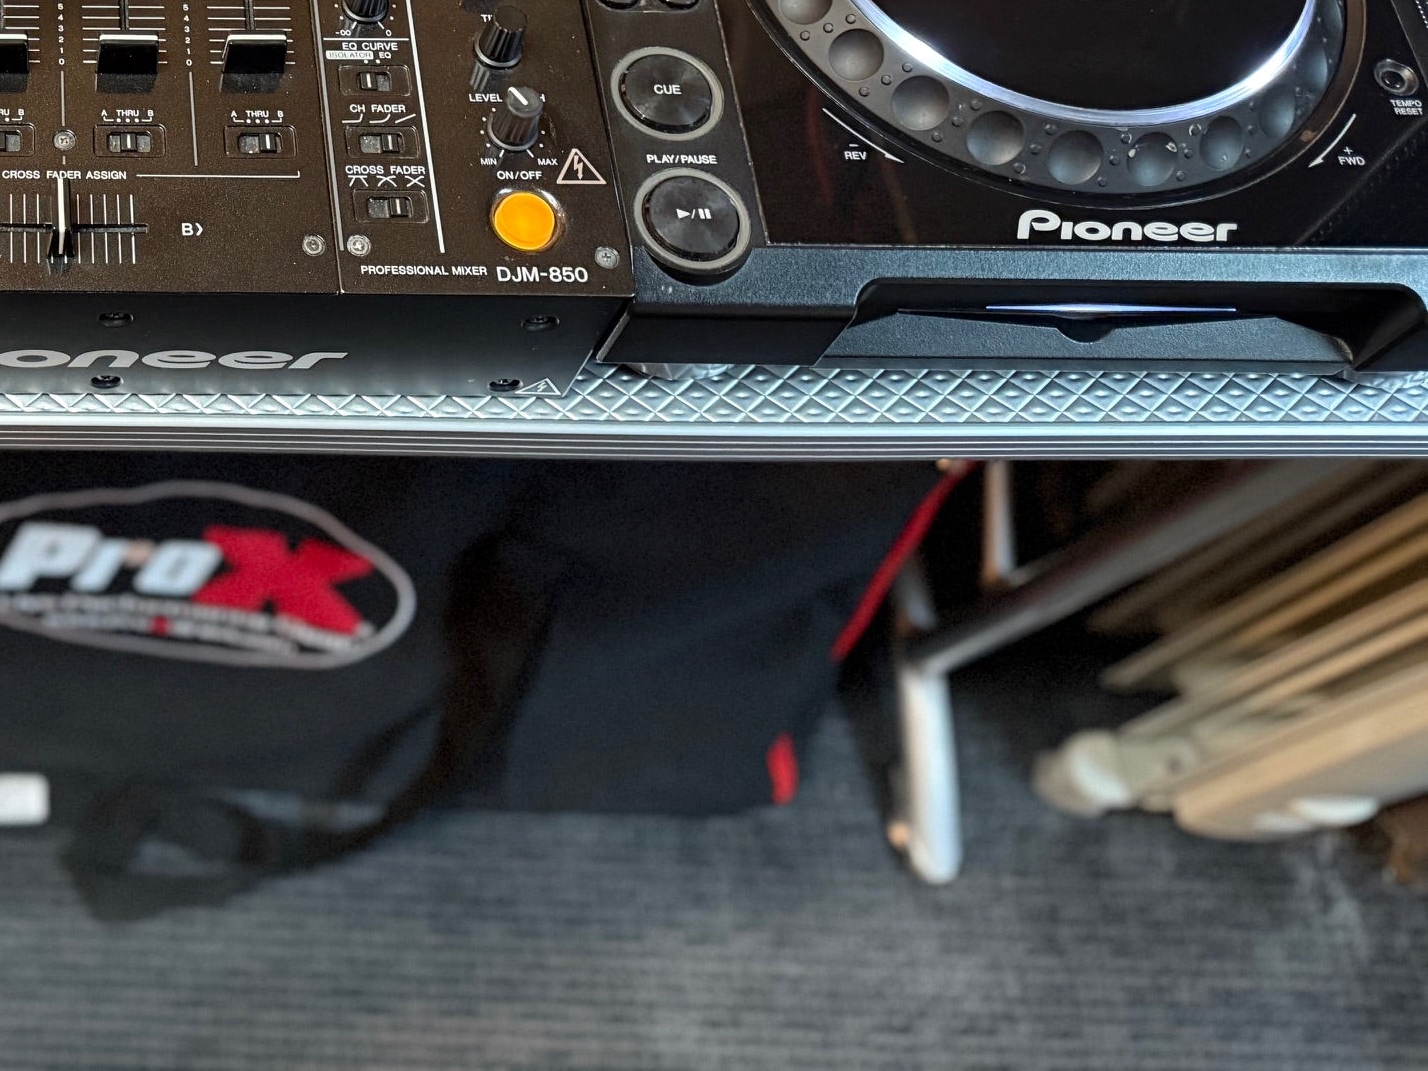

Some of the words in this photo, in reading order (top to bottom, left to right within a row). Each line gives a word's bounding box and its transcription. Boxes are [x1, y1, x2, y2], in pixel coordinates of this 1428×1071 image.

[342, 42, 357, 51] EQ
[362, 42, 398, 50] CURVE
[653, 84, 681, 95] CUE
[469, 94, 502, 102] LEVEL
[350, 105, 365, 113] CH
[371, 105, 406, 113] FADER
[1394, 107, 1423, 115] RESET
[646, 154, 718, 164] PLAY/PAUSE
[845, 151, 866, 160] REV
[538, 158, 558, 166] MAX
[1338, 157, 1365, 166] FWD
[345, 166, 384, 174] CROSS
[390, 166, 425, 174] FADER
[2, 170, 41, 179] CROSS
[46, 170, 81, 179] FADER
[86, 170, 127, 180] ASSIGN
[497, 171, 542, 179] ON/OFF
[1017, 209, 1237, 242] Pioneer
[360, 266, 449, 275] PROFESSIONAL
[452, 266, 487, 275] MIXER
[496, 267, 588, 282] DJM-850
